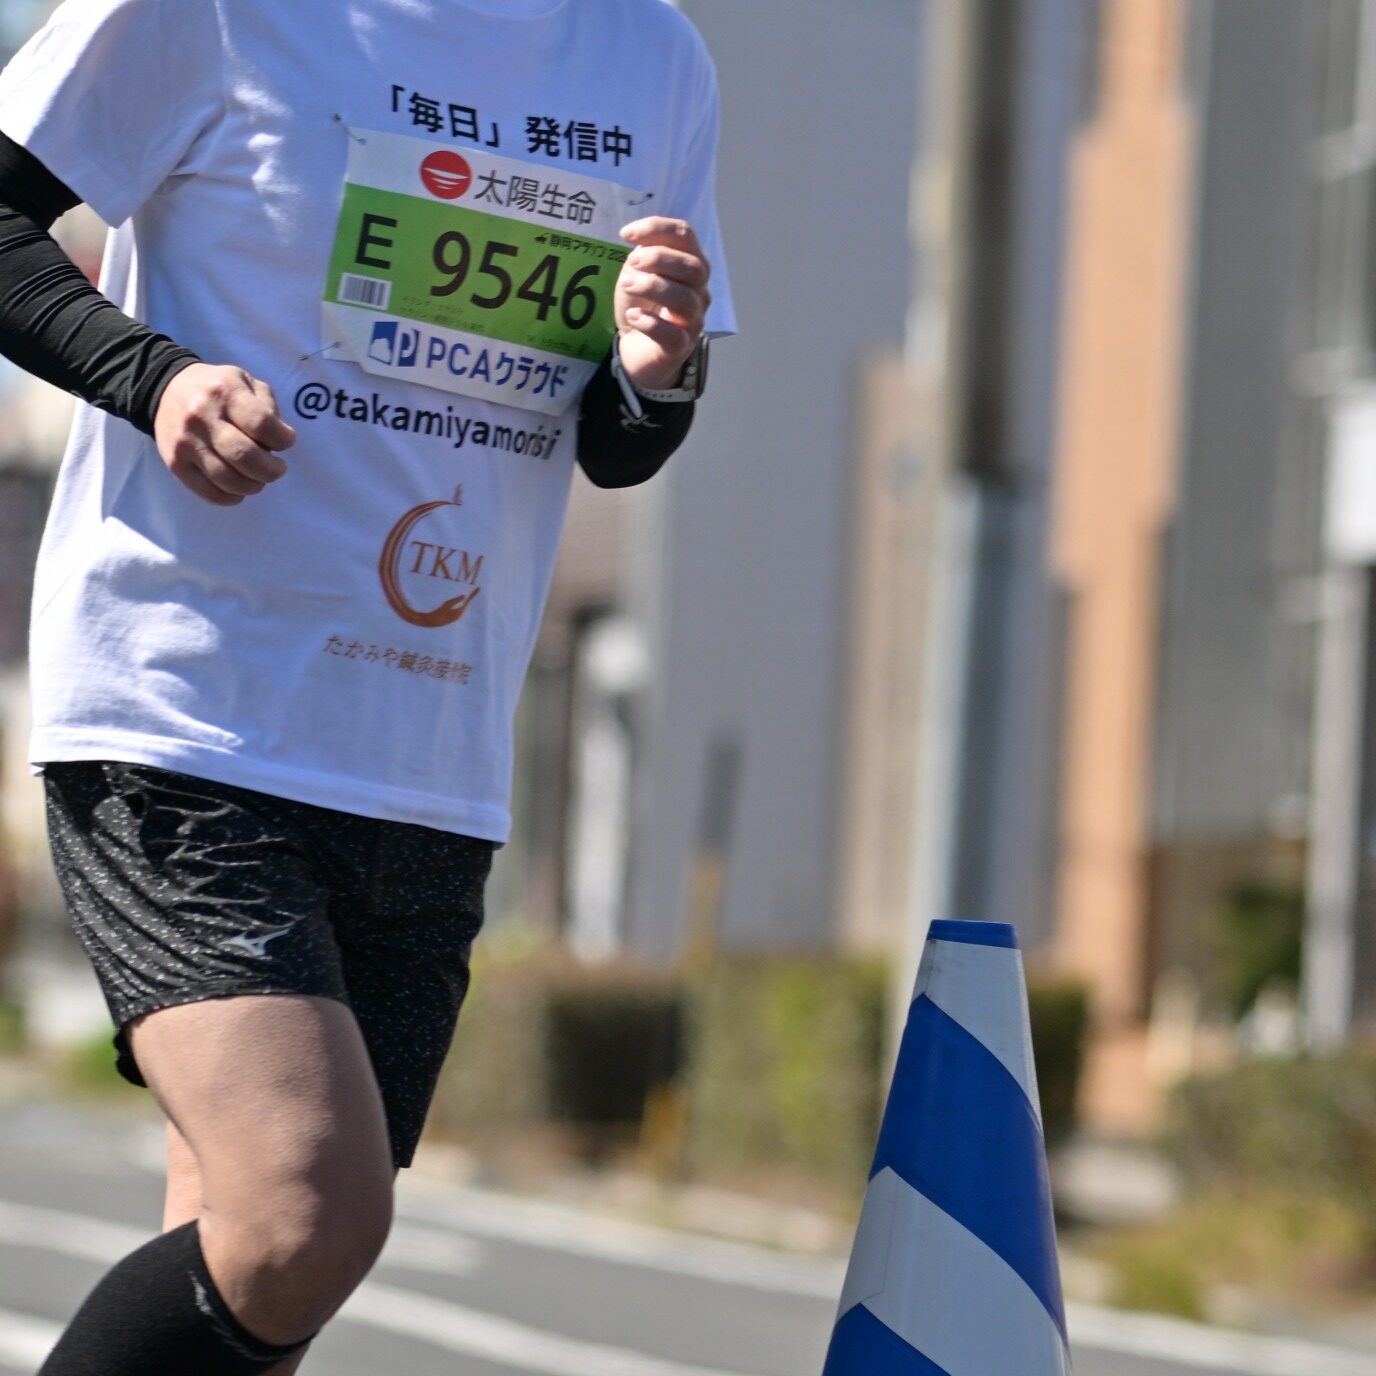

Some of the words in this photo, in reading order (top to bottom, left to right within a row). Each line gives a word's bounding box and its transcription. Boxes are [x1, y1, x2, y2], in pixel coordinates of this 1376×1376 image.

[473, 169, 597, 225] 太陽生命
[354, 213, 398, 270] E
[430, 230, 600, 330] 9546
[426, 336, 569, 398] PCAクラウド
[410, 541, 484, 585] TKM
